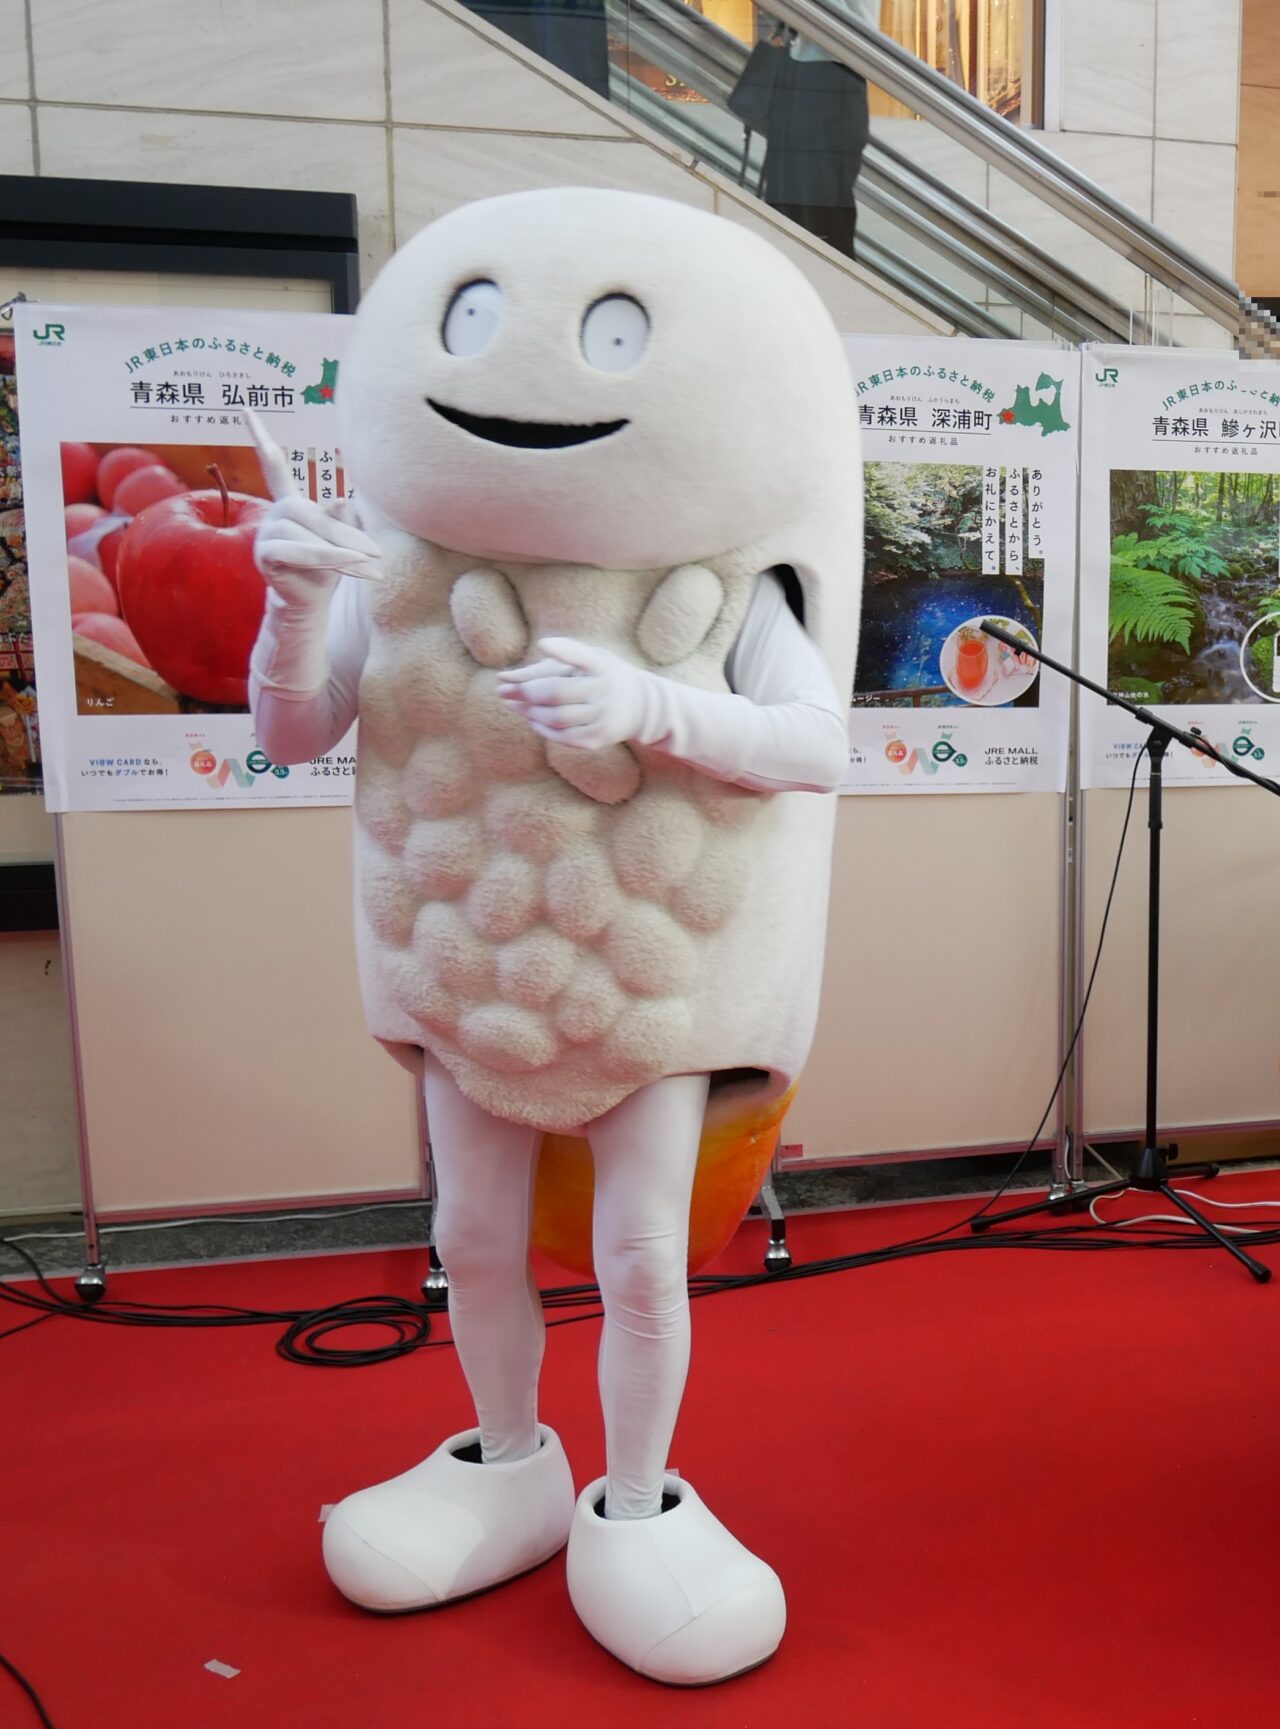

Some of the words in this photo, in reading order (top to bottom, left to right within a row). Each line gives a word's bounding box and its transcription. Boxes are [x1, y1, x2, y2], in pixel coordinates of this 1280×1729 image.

[33, 323, 65, 341] JR
[124, 337, 297, 378] JR東日本のふるさと納税
[1096, 368, 1118, 383] JR
[130, 380, 205, 405] 青森県
[221, 384, 296, 408] 弘前市
[170, 415, 250, 425] おすすめ返礼
[858, 404, 918, 427] 青森県
[931, 407, 992, 430] 深浦町
[1152, 416, 1209, 437] 青森県
[888, 435, 958, 446] おすすめ返礼品
[1194, 446, 1258, 456] おすすめ返礼品
[985, 467, 997, 570] お礼にかえて。
[1008, 468, 1020, 571] ふるさとから、
[1031, 469, 1043, 554] ありがとう。
[86, 698, 115, 707] りんご
[985, 747, 1004, 755] JRE
[1008, 747, 1038, 755] MALL
[116, 758, 142, 766] CARD
[985, 756, 1038, 766] ふるさと納税
